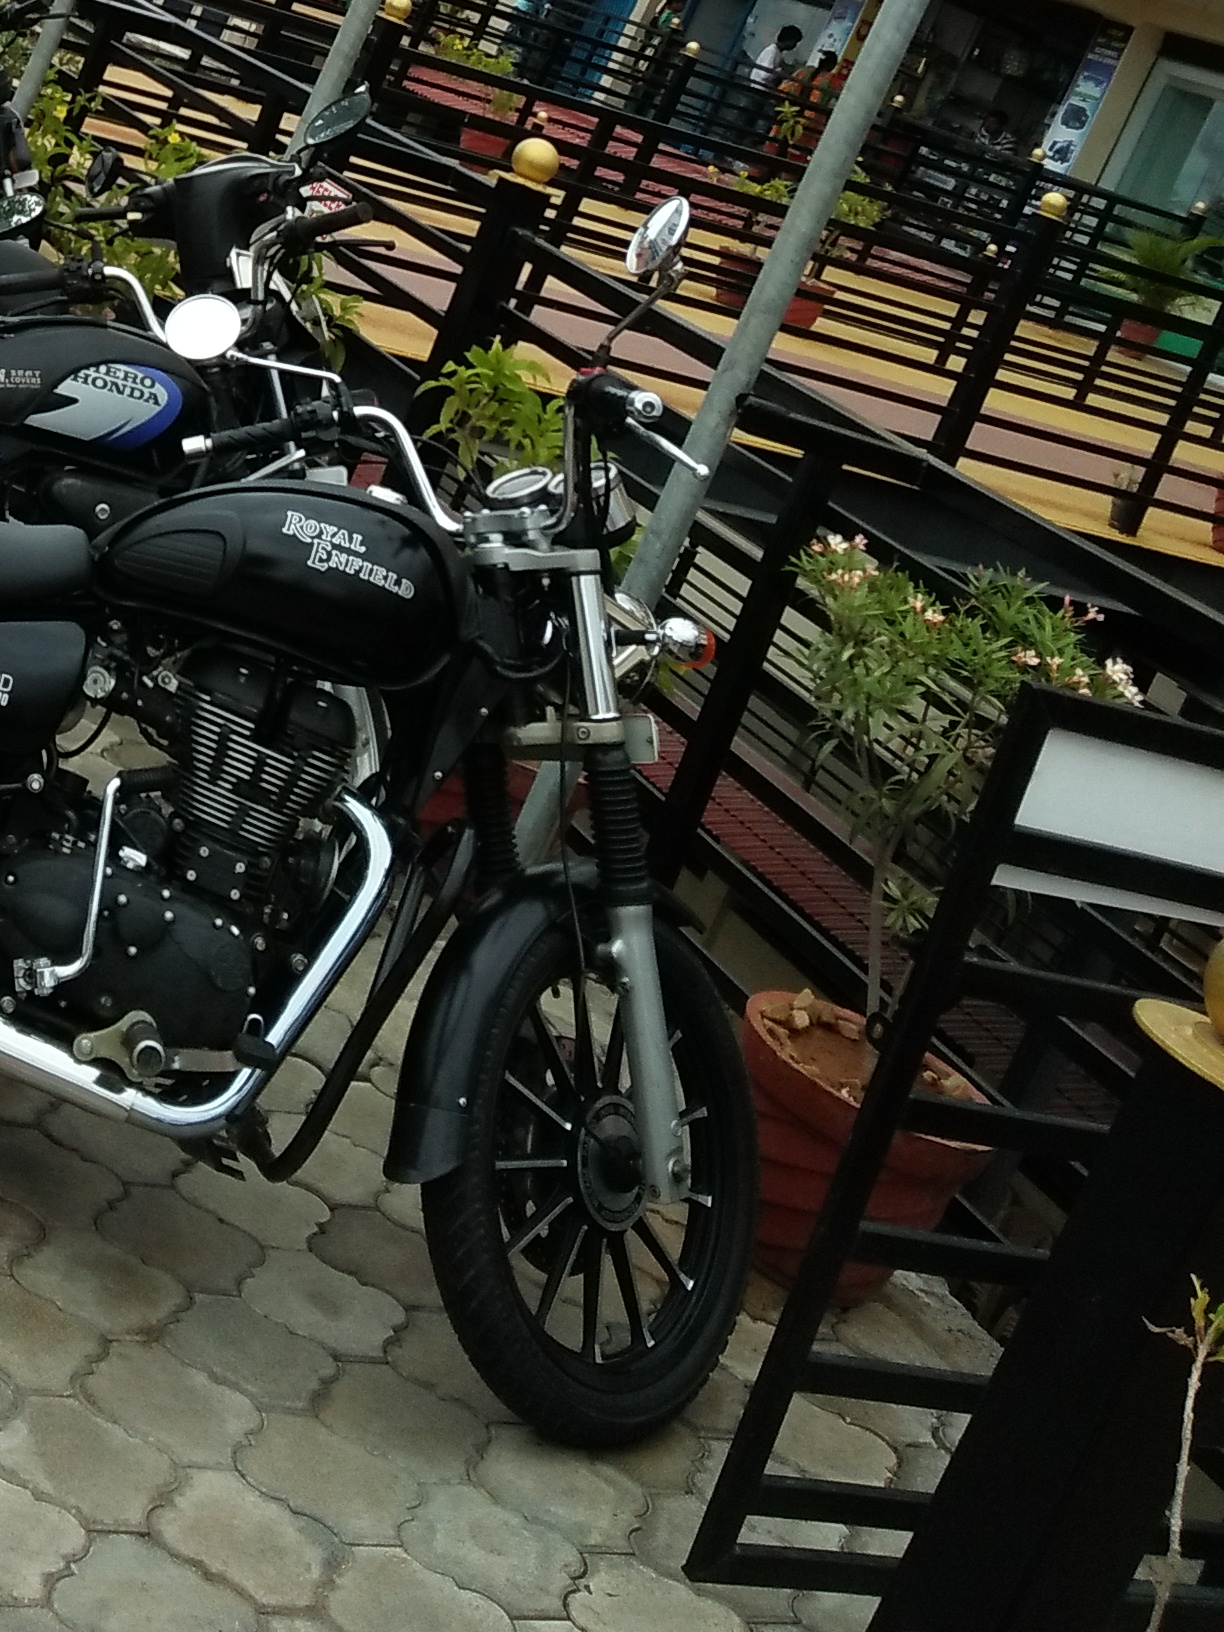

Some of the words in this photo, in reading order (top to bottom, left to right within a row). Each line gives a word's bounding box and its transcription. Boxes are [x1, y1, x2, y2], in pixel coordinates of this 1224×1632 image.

[70, 372, 162, 407] HONDA
[281, 510, 366, 554] ROYAL
[306, 539, 416, 600] ENFIELD
